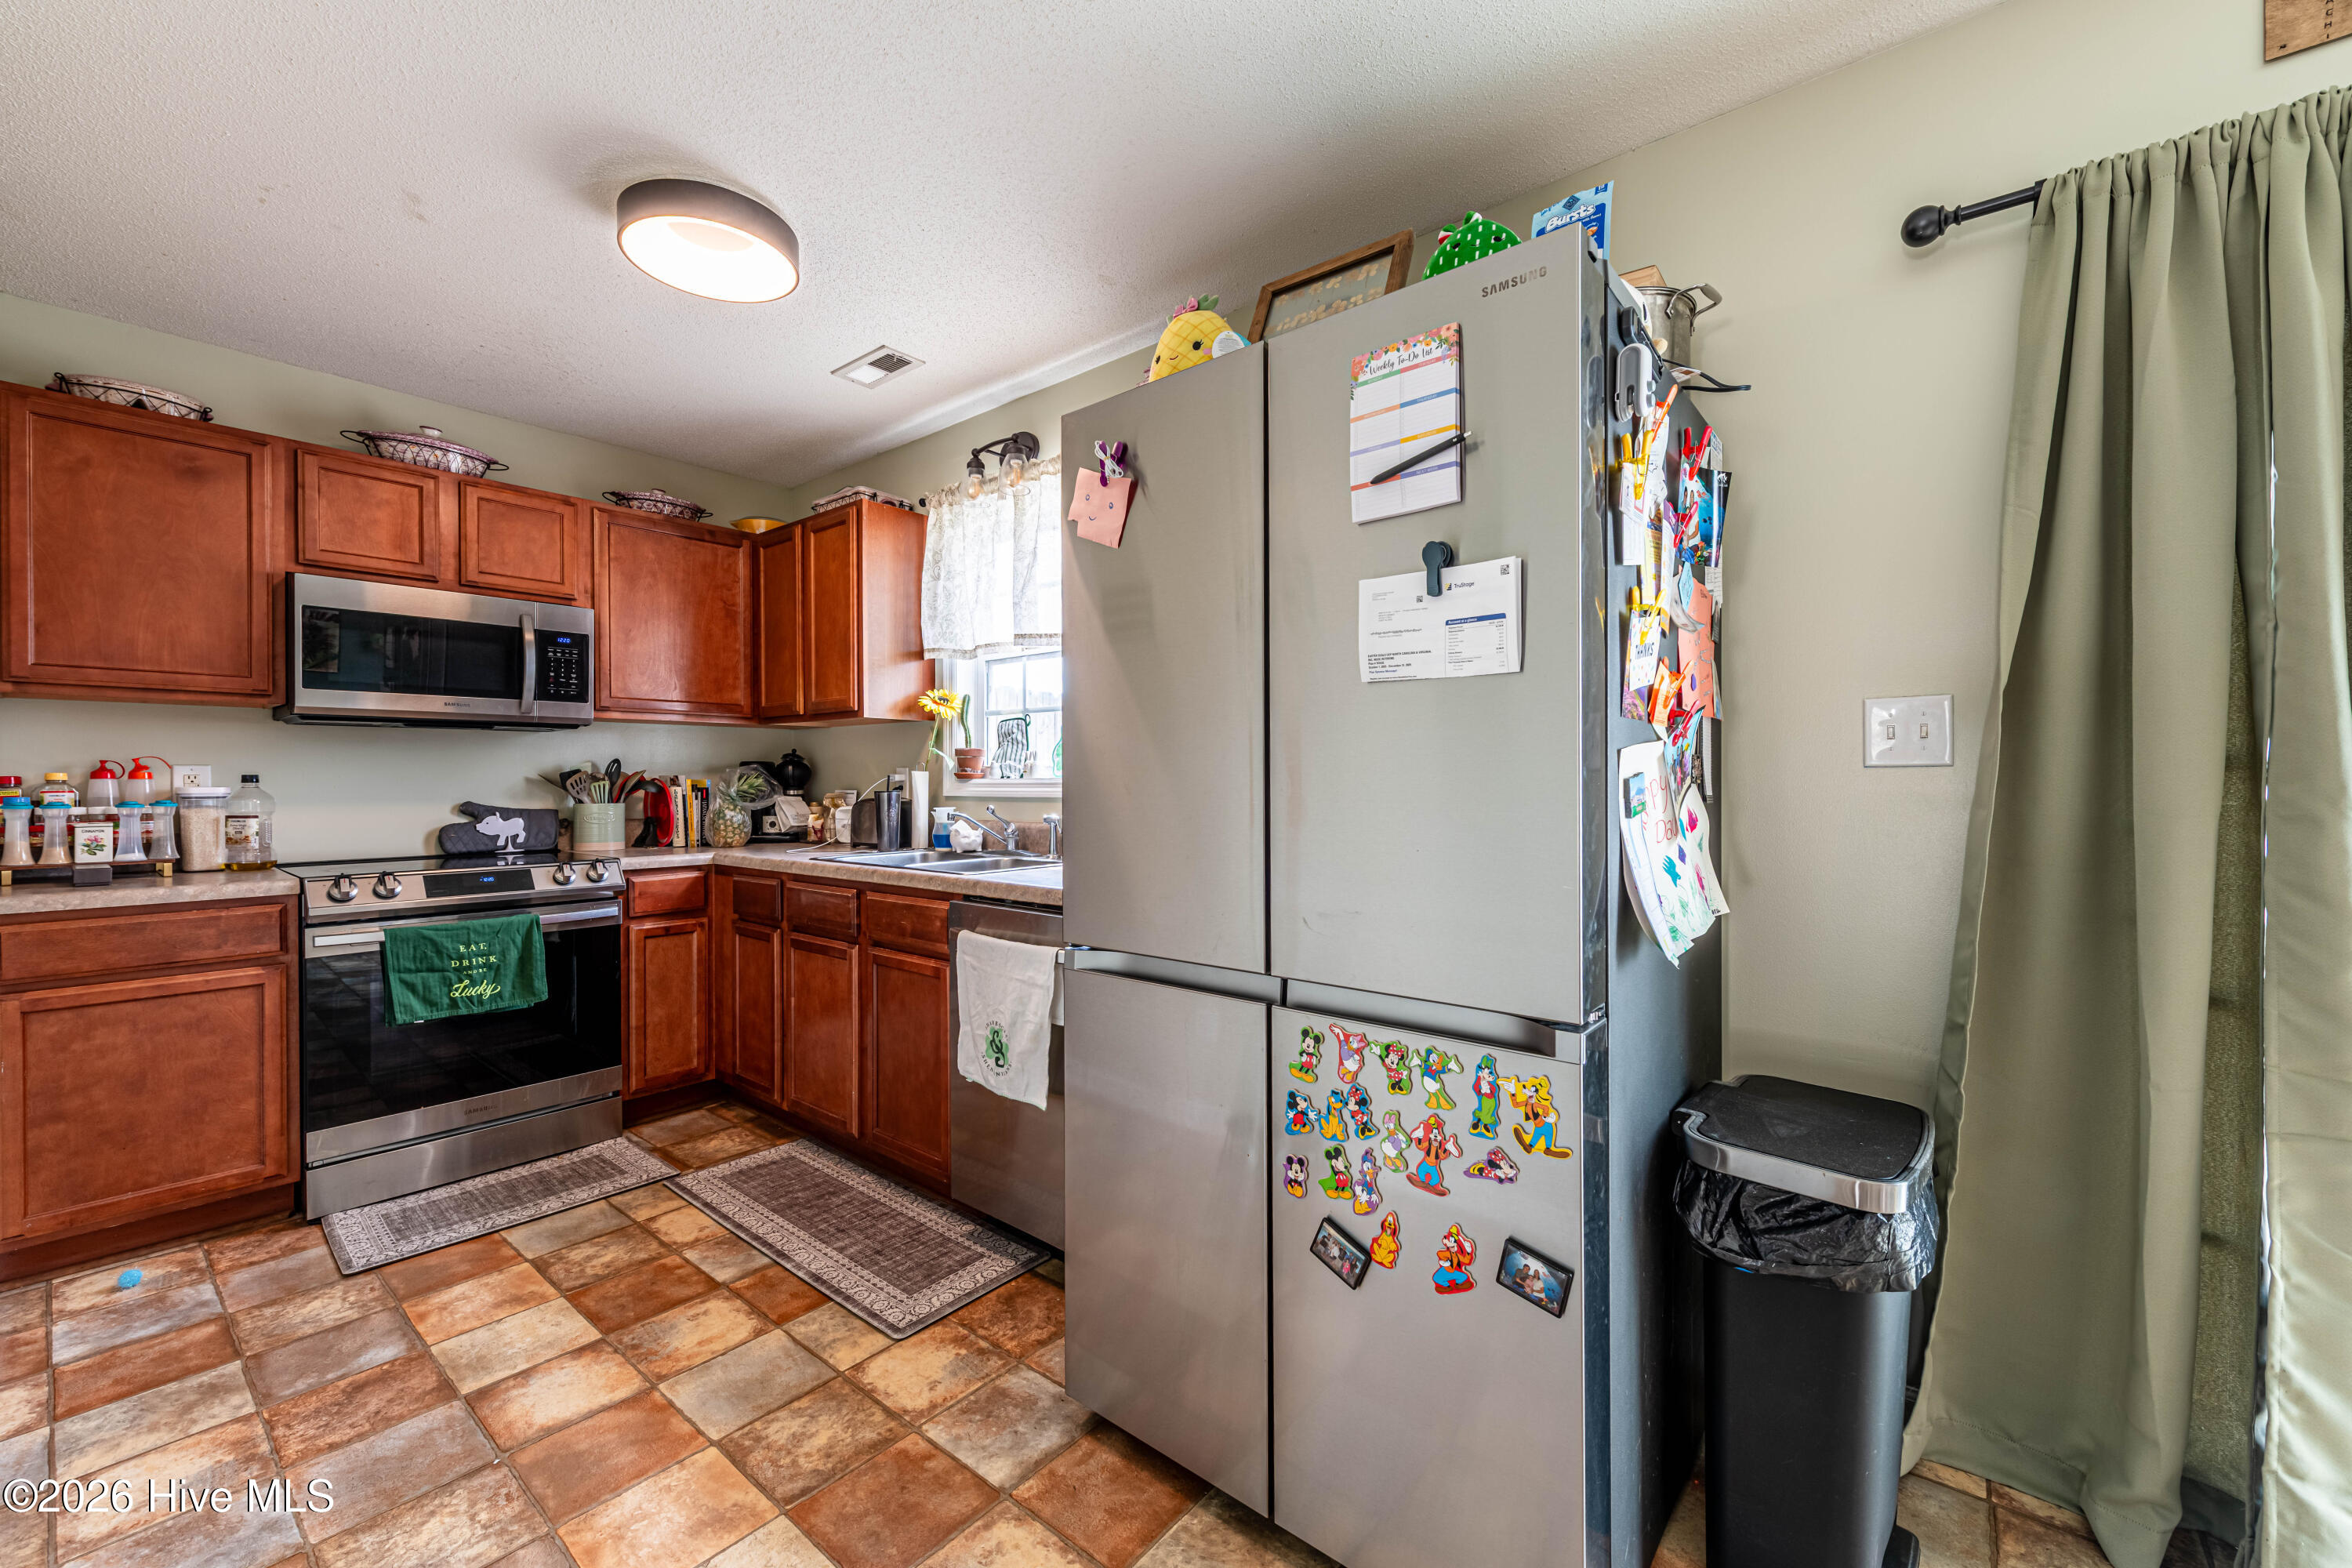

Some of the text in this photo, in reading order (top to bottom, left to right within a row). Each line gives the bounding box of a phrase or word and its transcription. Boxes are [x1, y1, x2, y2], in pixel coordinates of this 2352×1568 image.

[1545, 203, 1595, 233] Bursts
[1482, 266, 1547, 298] SAMSUNG
[1370, 347, 1433, 375] Weekly To-Do List
[1635, 642, 1655, 659] THANKS
[452, 956, 497, 967] DRINK
[451, 979, 500, 999] Lucky
